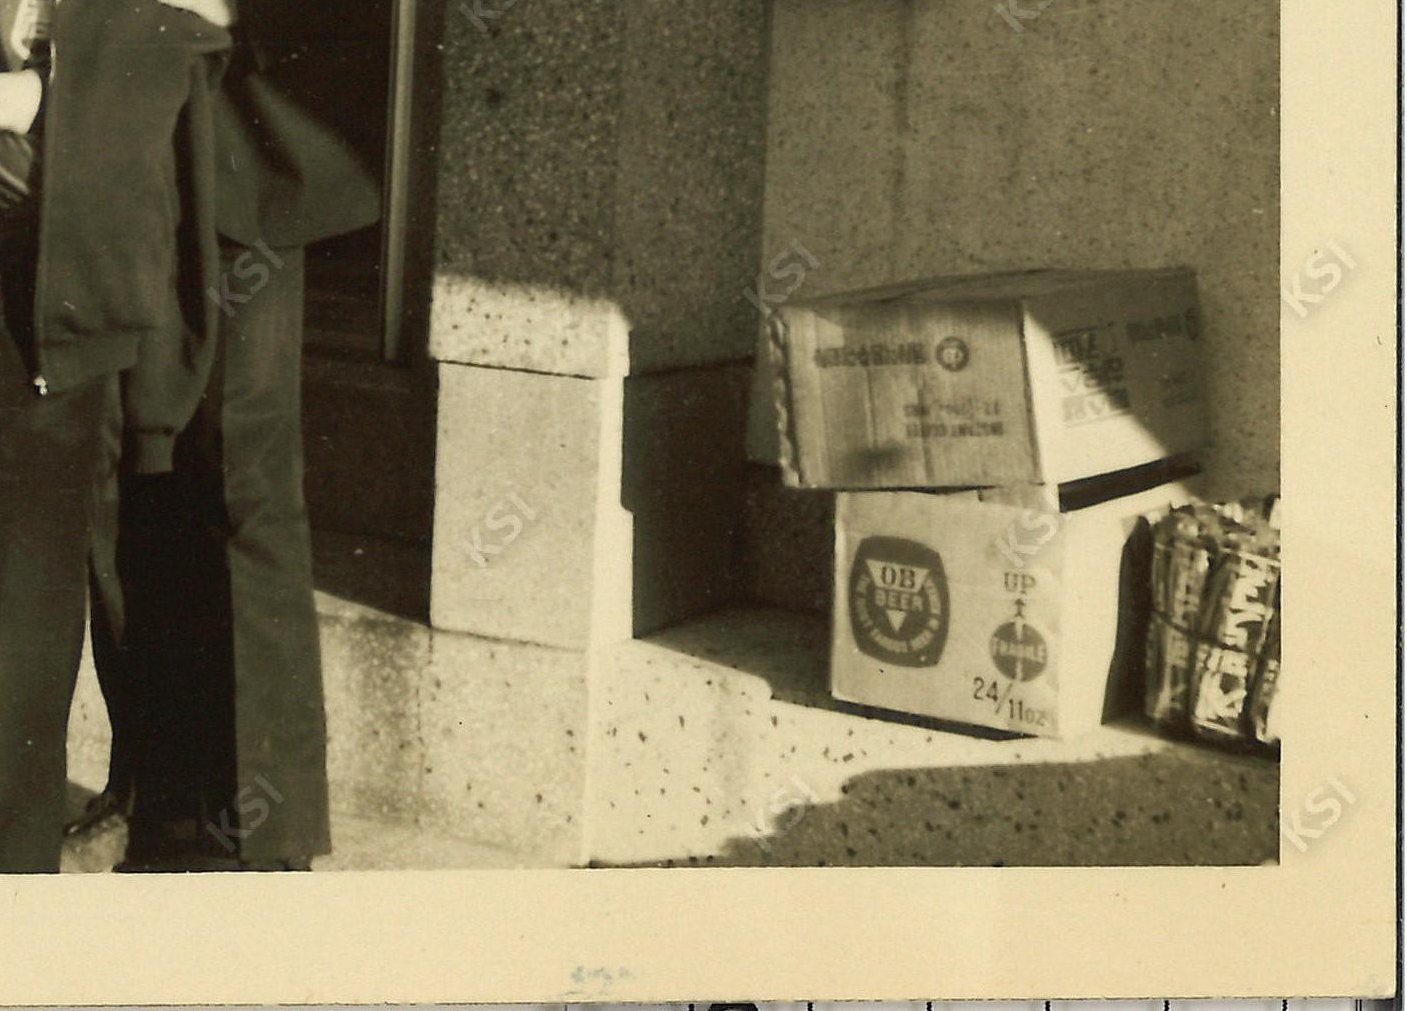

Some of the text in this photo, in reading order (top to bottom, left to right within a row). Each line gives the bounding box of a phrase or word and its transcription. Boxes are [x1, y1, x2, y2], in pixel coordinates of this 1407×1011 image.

[879, 566, 916, 589] OB
[1003, 572, 1037, 594] UP
[873, 589, 924, 611] BEER
